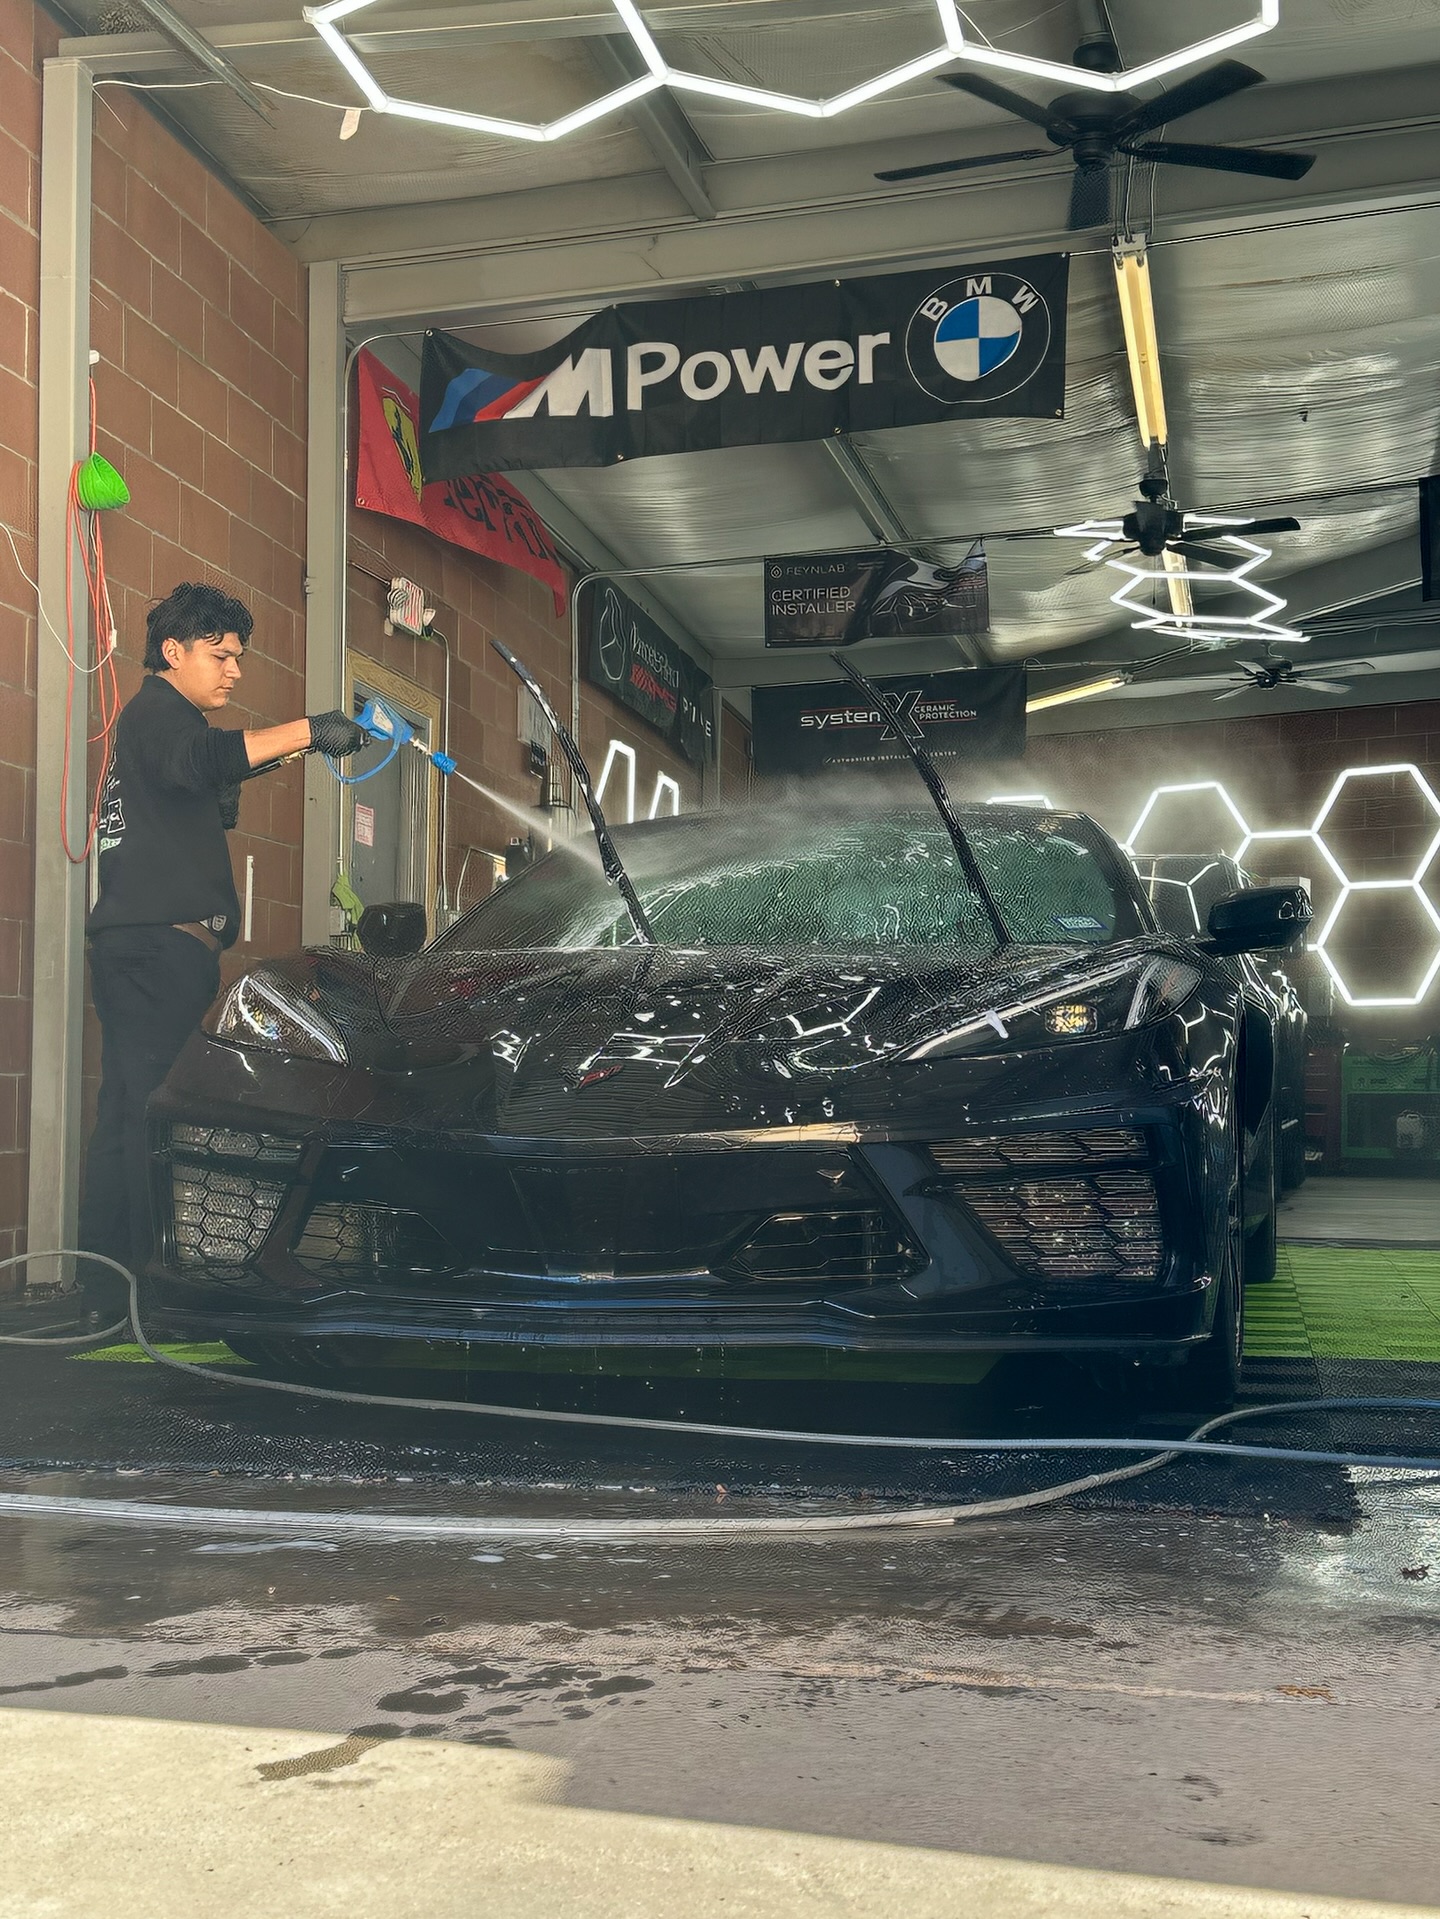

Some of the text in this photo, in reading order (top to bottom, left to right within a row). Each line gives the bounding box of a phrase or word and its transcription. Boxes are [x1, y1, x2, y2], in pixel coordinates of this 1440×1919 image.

[920, 275, 1039, 322] BMW
[786, 563, 846, 576] FEYNLAB
[771, 586, 851, 602] CERTIFIED
[772, 600, 856, 616] INSTALLER
[914, 703, 956, 714] CERAMIC
[919, 709, 978, 720] PROTECTION
